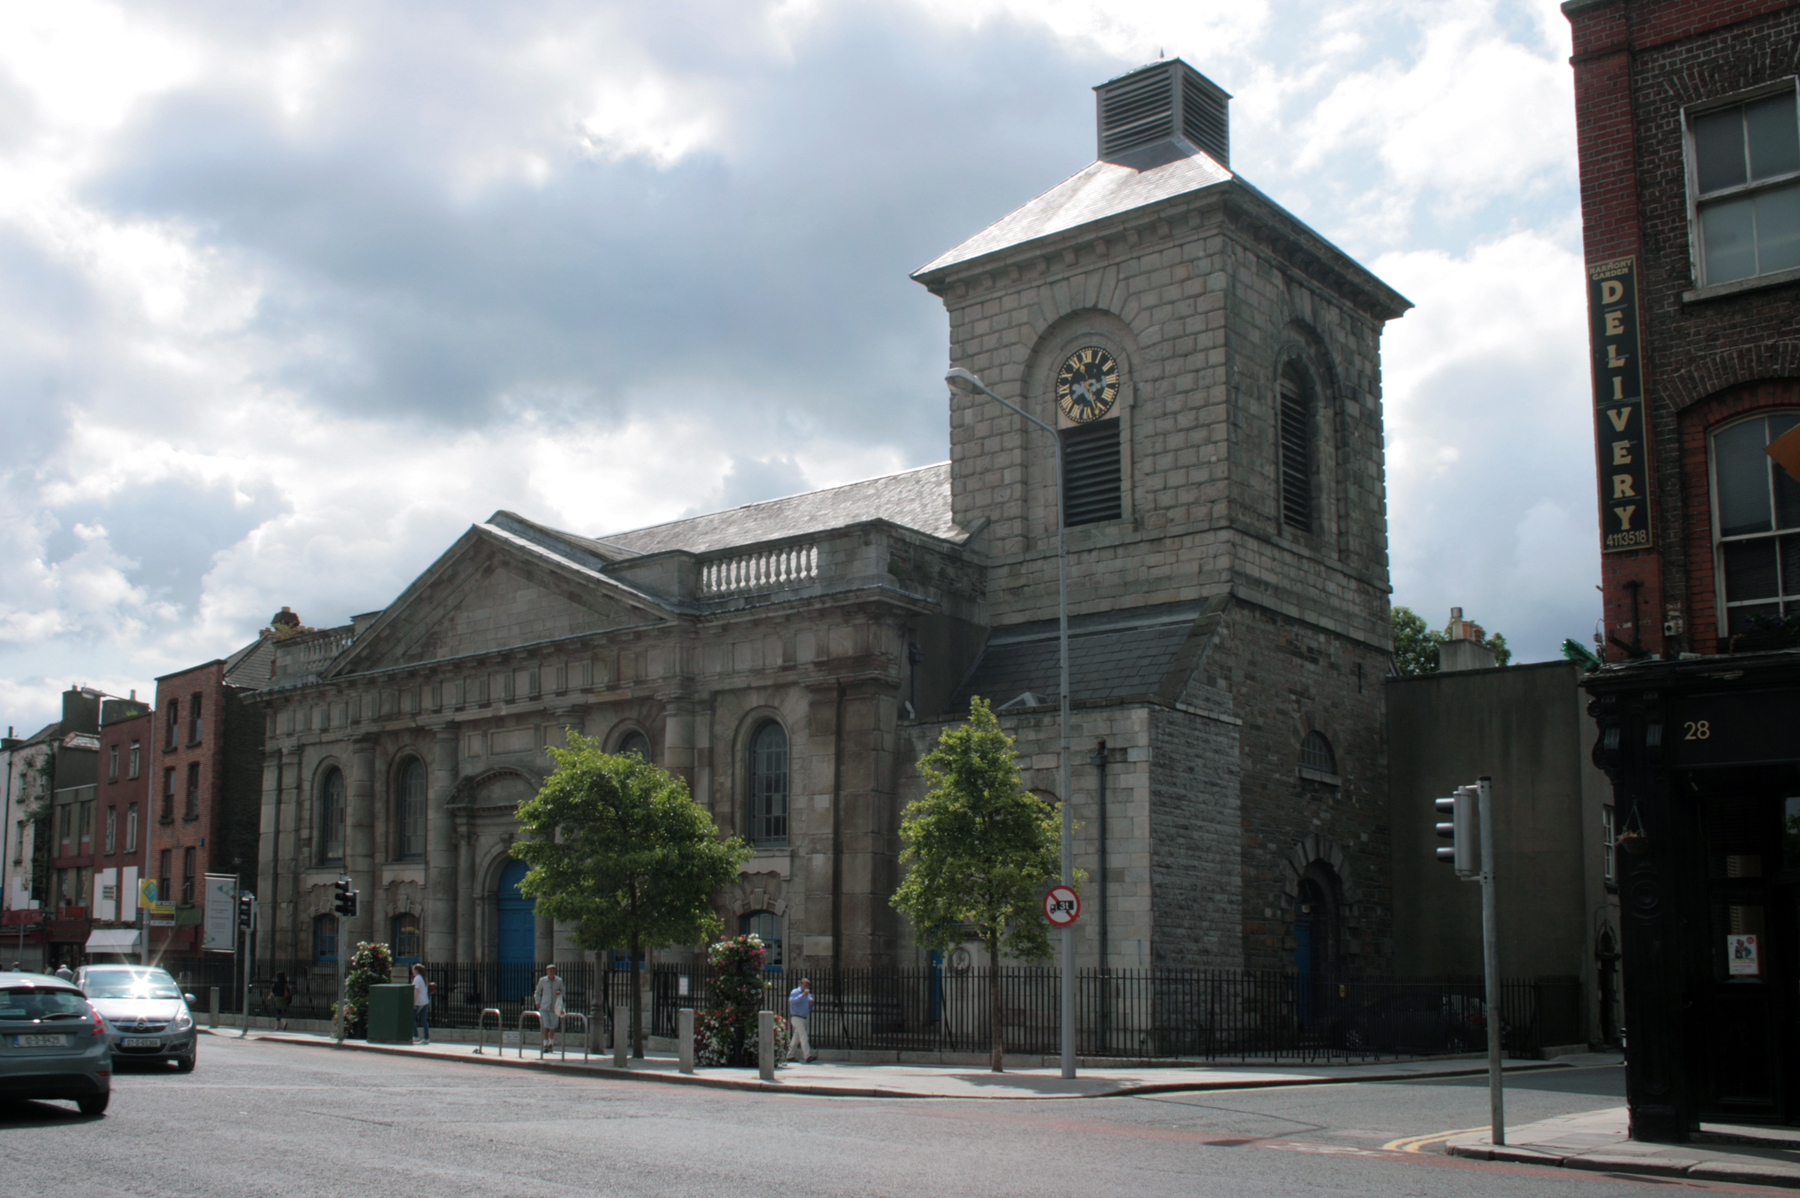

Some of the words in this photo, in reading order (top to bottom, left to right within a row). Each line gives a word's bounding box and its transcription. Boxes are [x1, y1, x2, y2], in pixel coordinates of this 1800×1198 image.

[1589, 259, 1632, 275] HARMONY
[1592, 267, 1629, 281] GARDEN
[1601, 279, 1636, 530] DELIVERY
[1606, 529, 1647, 547] 4113518
[1684, 720, 1711, 740] 28
[1060, 901, 1070, 910] 3t
